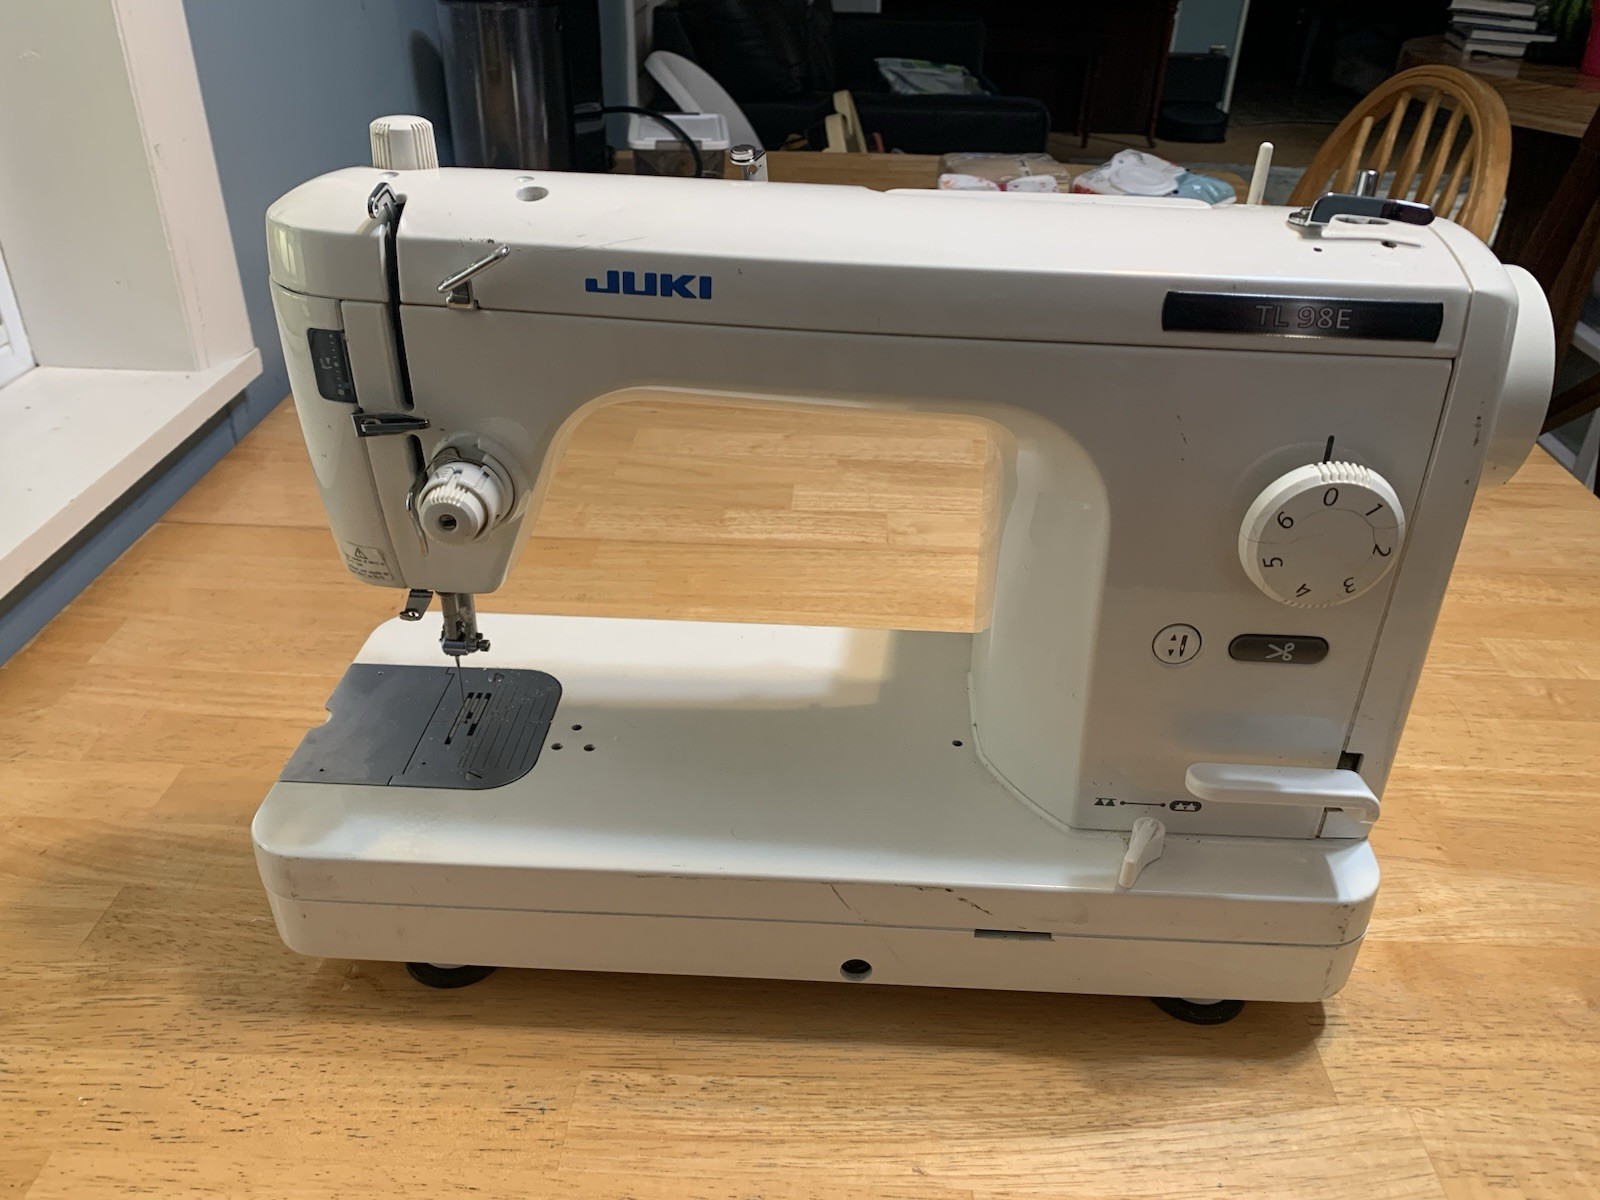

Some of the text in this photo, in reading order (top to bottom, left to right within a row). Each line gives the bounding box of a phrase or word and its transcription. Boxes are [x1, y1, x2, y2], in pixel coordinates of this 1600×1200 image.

[585, 270, 712, 299] JUKI
[1255, 304, 1353, 330] TL 98E
[1323, 487, 1339, 506] 0
[1365, 503, 1384, 517] 1
[1277, 511, 1294, 529] 6
[1372, 543, 1391, 557] 2
[1262, 556, 1284, 568] 5
[1295, 583, 1312, 598] 4
[1343, 577, 1356, 594] 3
